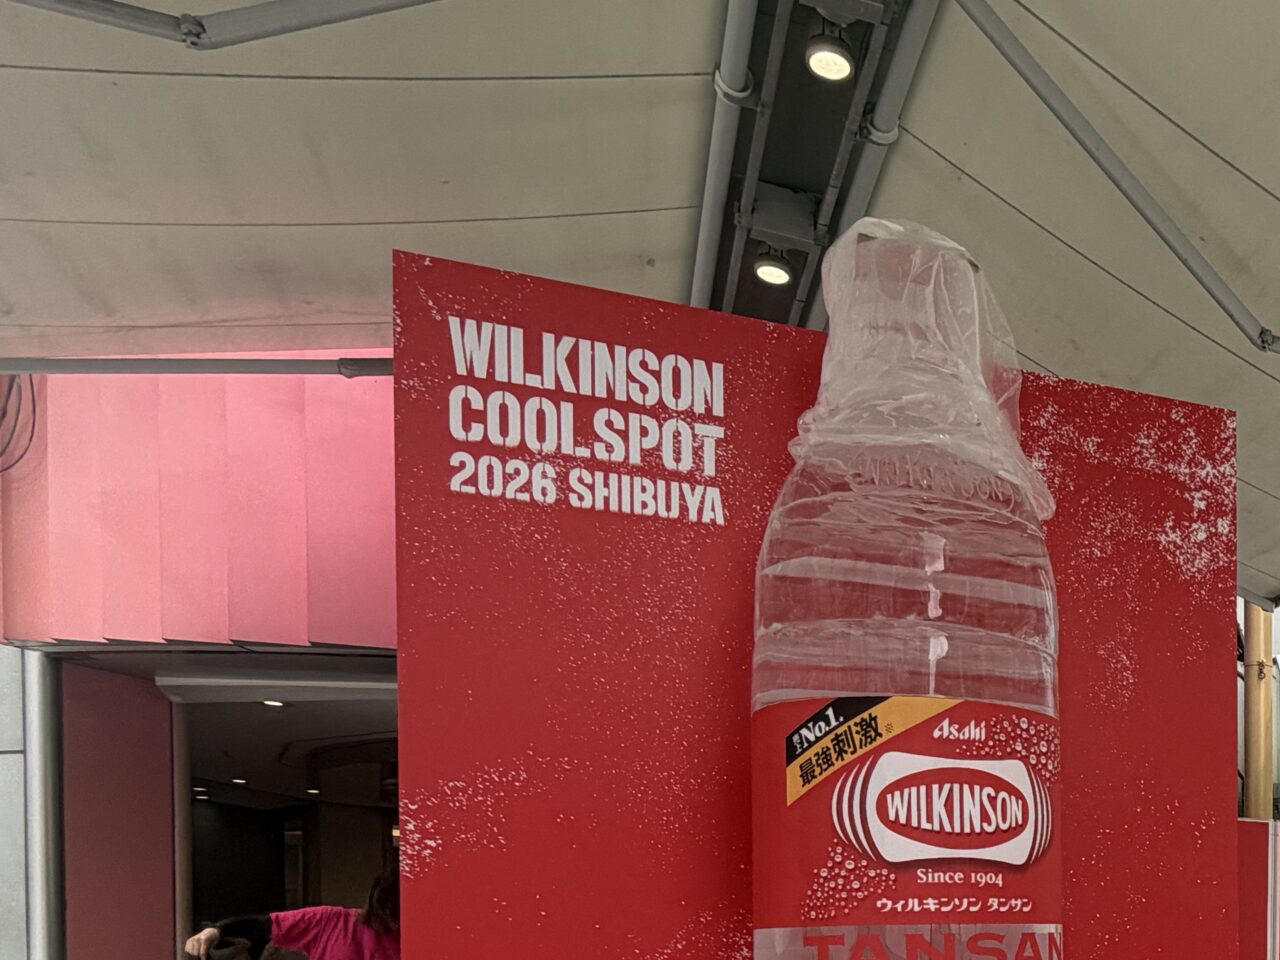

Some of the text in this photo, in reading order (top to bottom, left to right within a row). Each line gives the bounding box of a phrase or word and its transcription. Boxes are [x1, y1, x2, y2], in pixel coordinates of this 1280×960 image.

[448, 315, 725, 418] WILKINSON
[449, 384, 725, 478] COOL SPOT
[450, 451, 725, 527] 2026 SHIBUYA
[799, 712, 883, 788] 最強刺激
[932, 717, 986, 742] Asahi
[886, 783, 1024, 834] WILKINSON
[876, 897, 1032, 913] ウィルキンソン タンサン
[916, 868, 1004, 888] Since 1904
